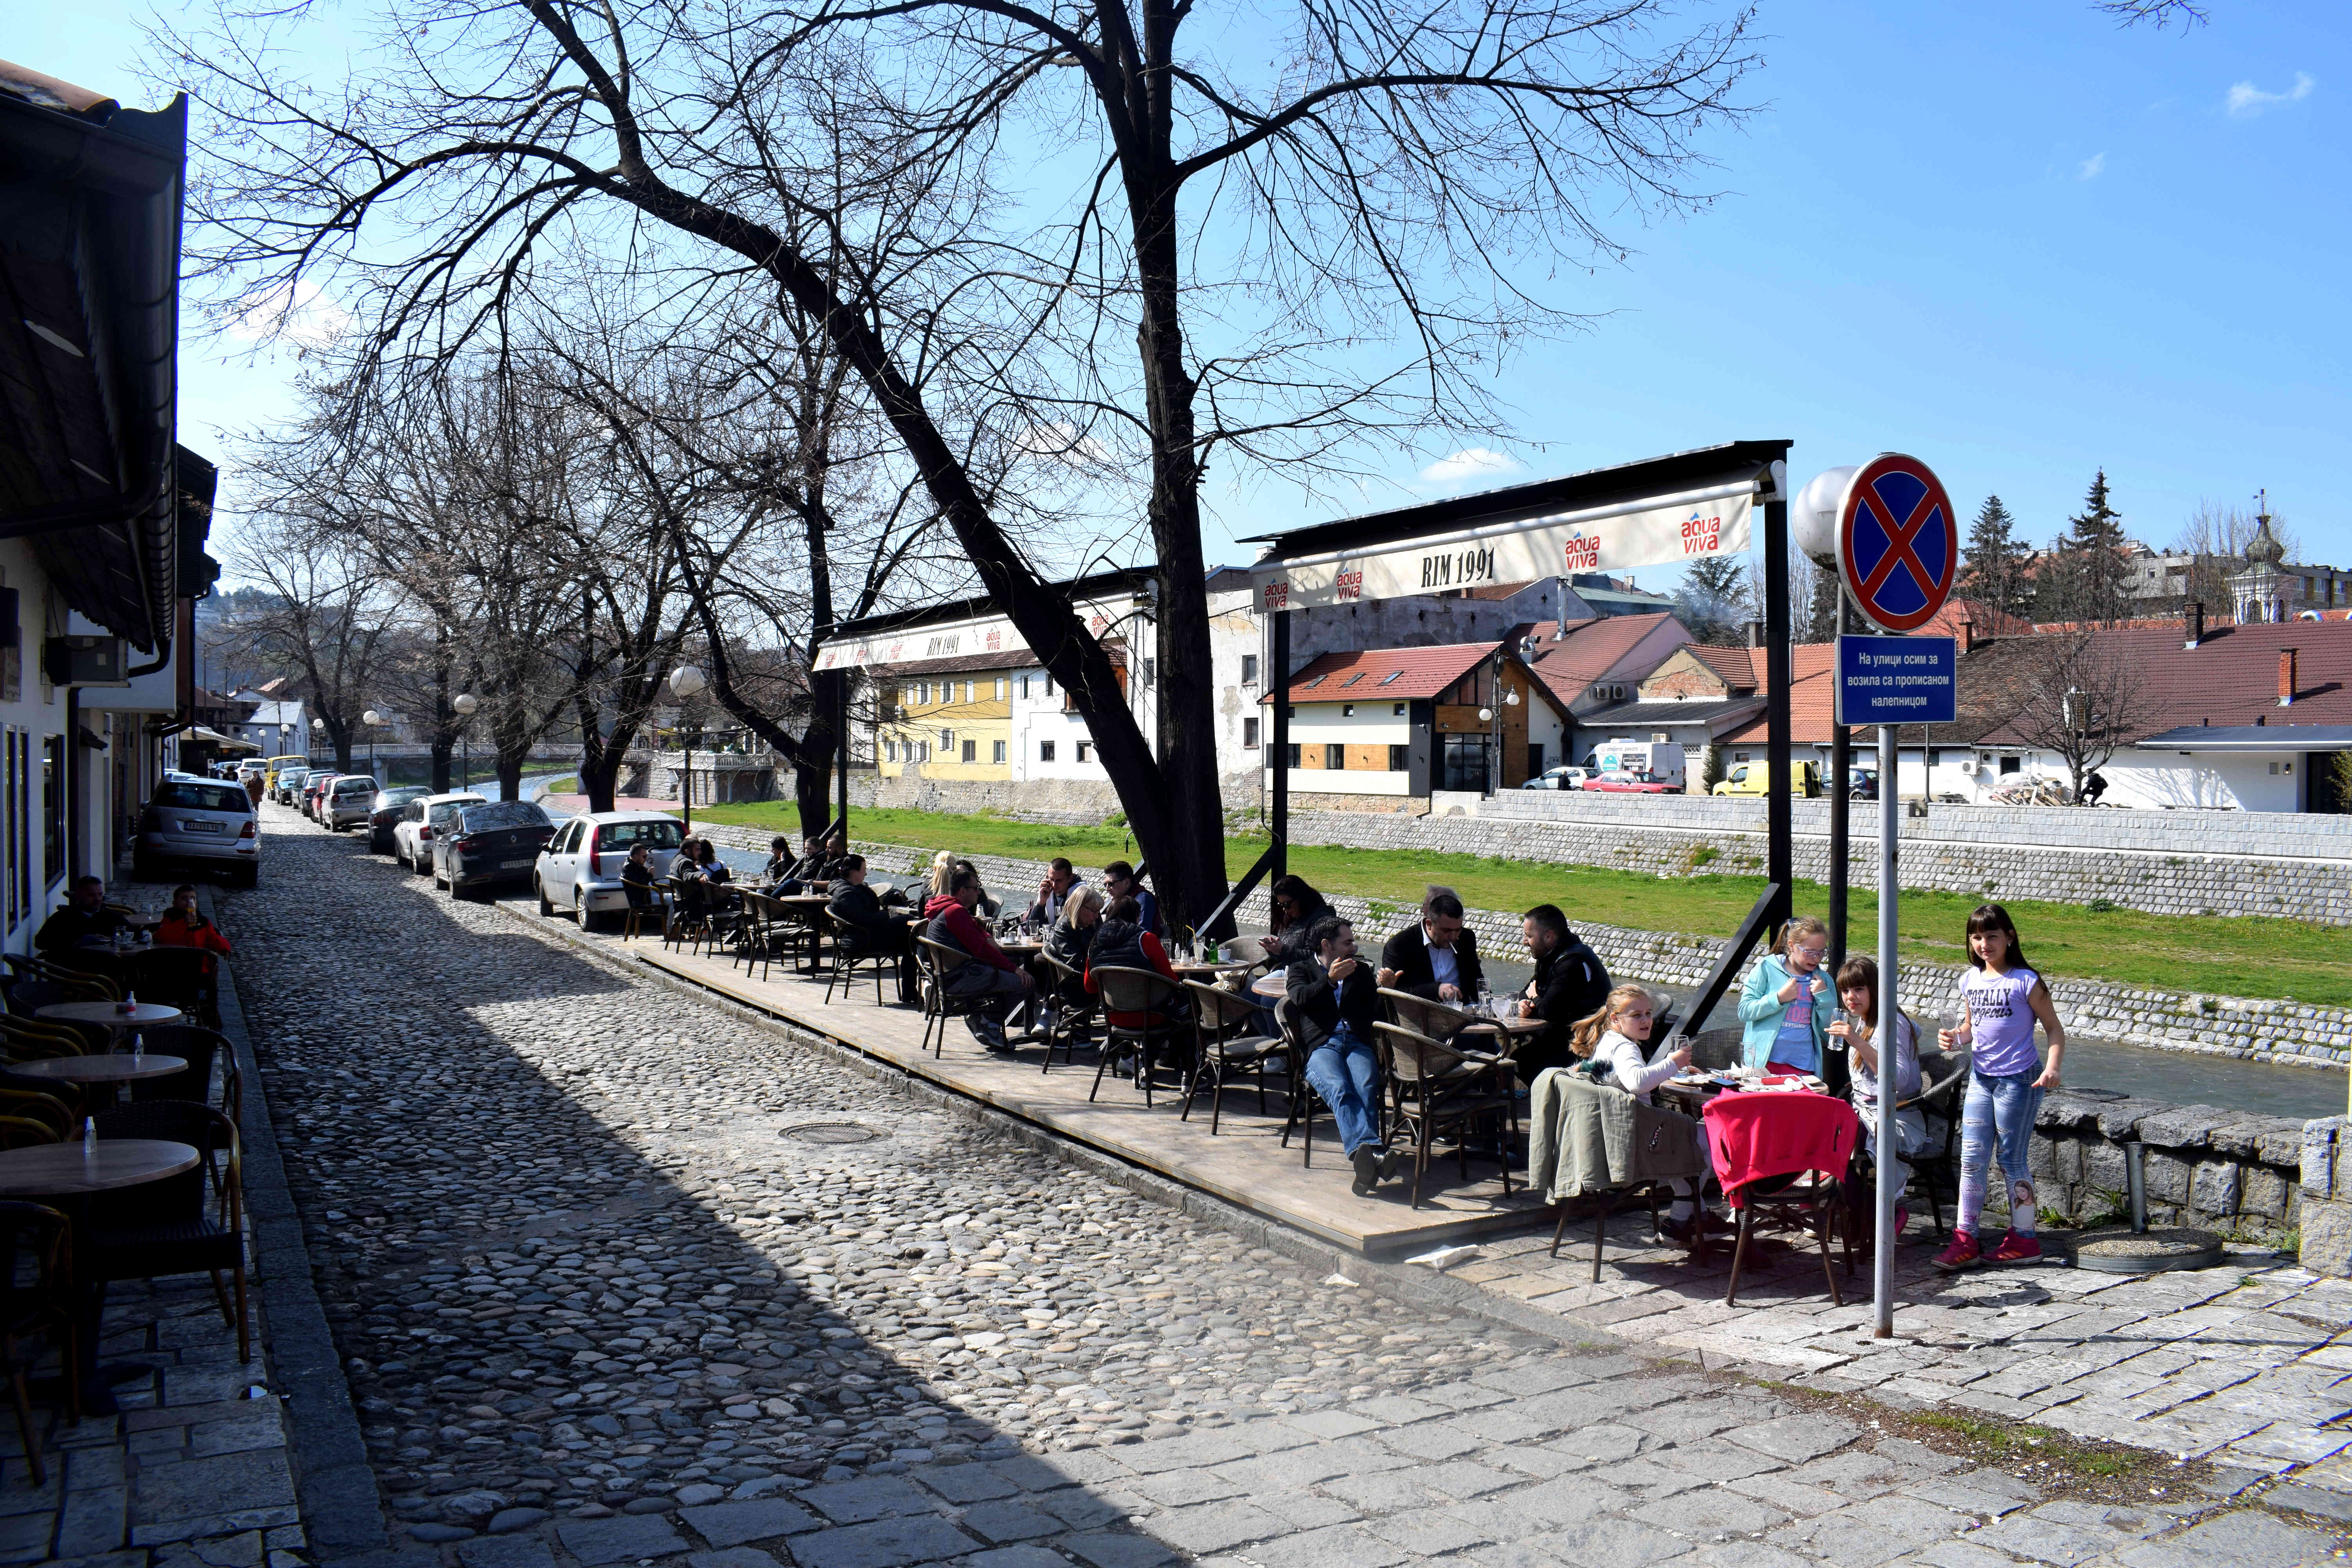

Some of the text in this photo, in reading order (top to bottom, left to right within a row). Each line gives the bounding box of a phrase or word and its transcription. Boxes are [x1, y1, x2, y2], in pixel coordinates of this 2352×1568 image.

[1421, 547, 1494, 588] RIM 1991
[927, 634, 960, 656] RIM 1991
[1859, 653, 1938, 667] На улици осим за
[1847, 676, 1949, 688] возила са прописаном
[1872, 697, 1927, 709] налепницом
[1967, 988, 2011, 1006] TOTALLY
[1971, 1007, 2013, 1026] orgeous
